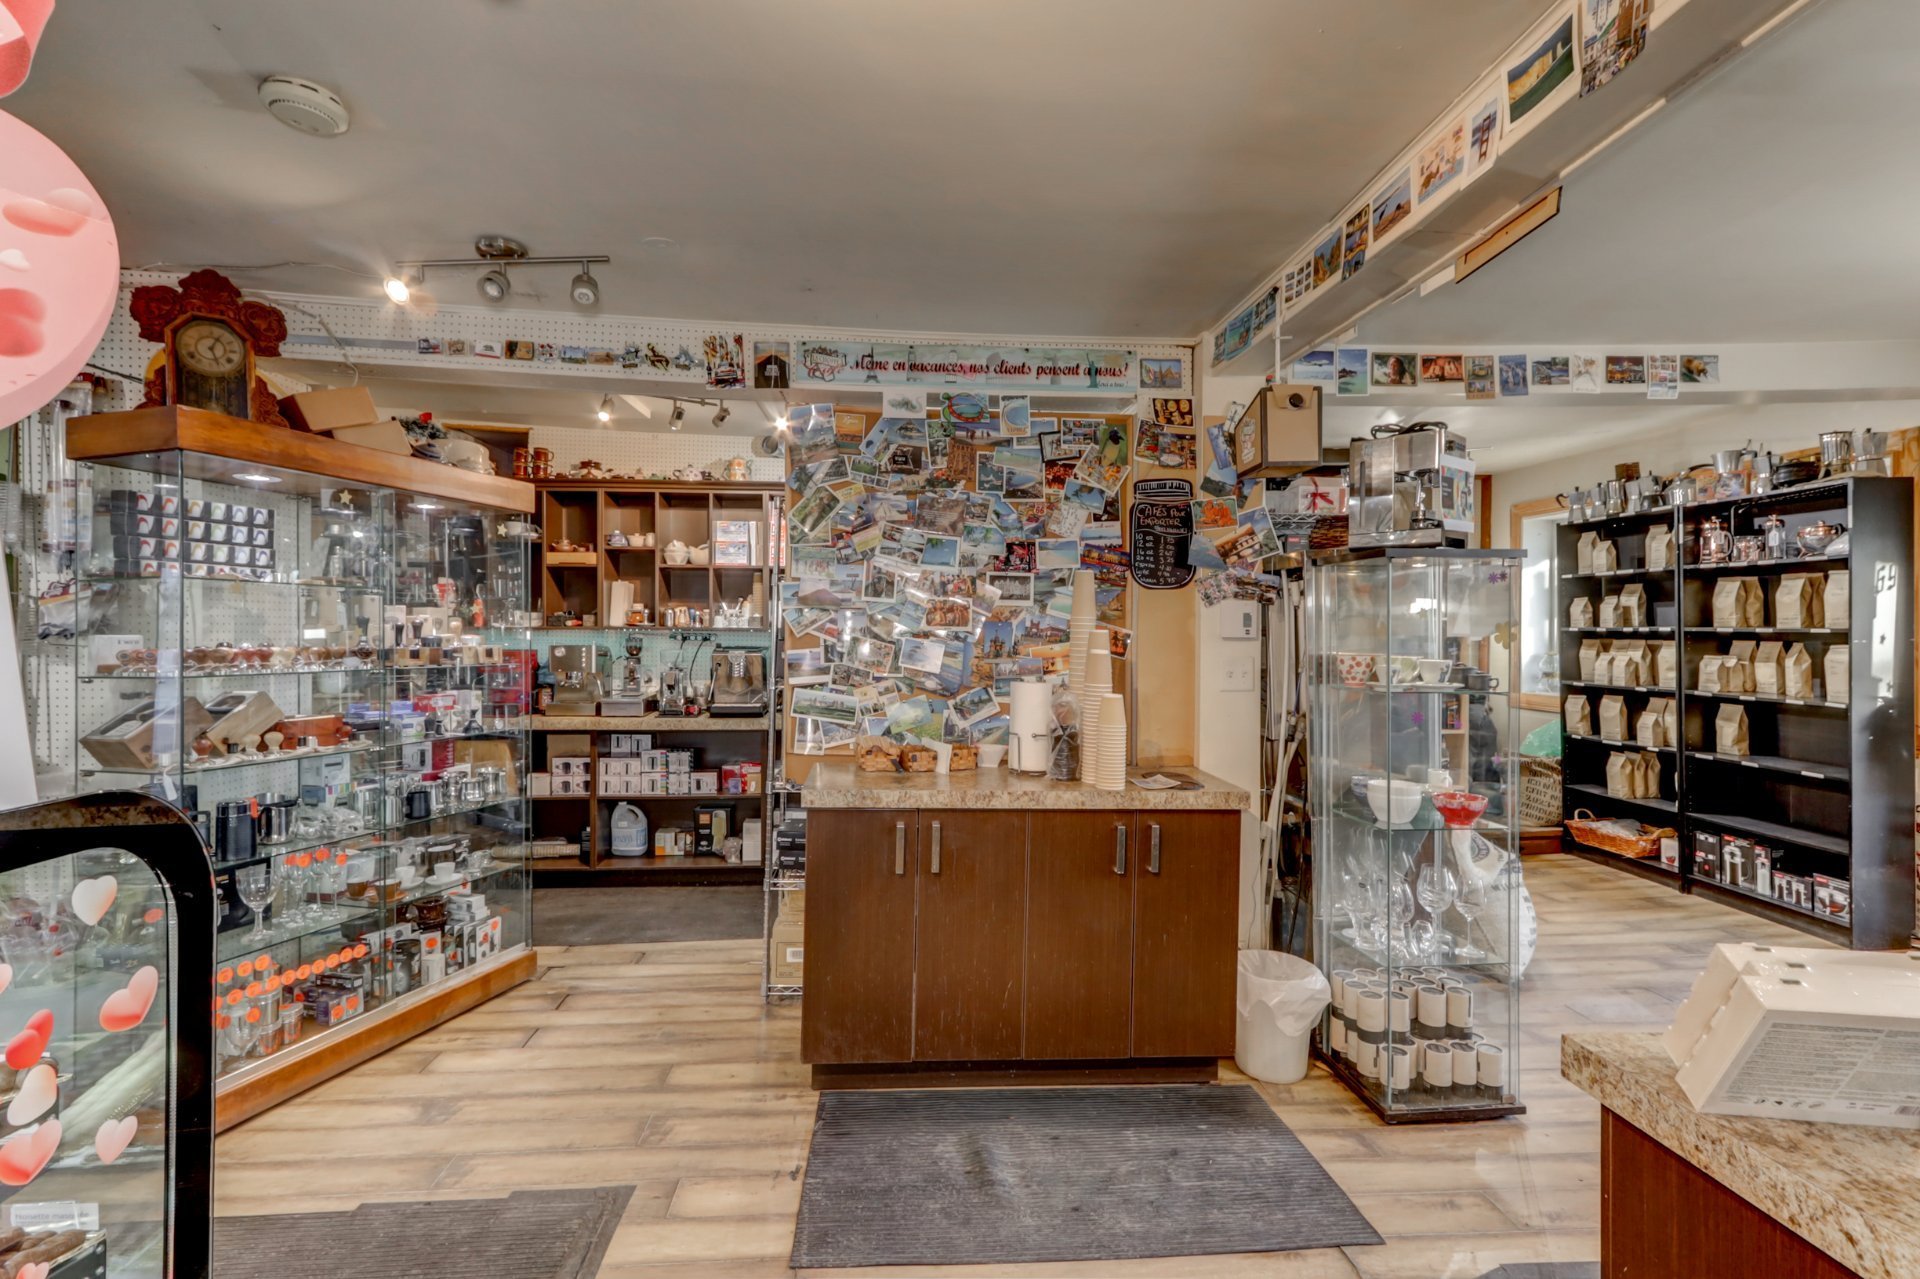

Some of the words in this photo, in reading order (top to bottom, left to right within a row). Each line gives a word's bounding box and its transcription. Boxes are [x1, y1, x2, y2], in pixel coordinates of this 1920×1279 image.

[892, 361, 906, 371] en
[910, 361, 966, 374] vacances,
[969, 363, 990, 374] nos
[994, 359, 1032, 375] clients
[1036, 363, 1080, 379] pensent
[1136, 504, 1167, 517] CAFÉS
[1140, 516, 1182, 527] EMPORTER
